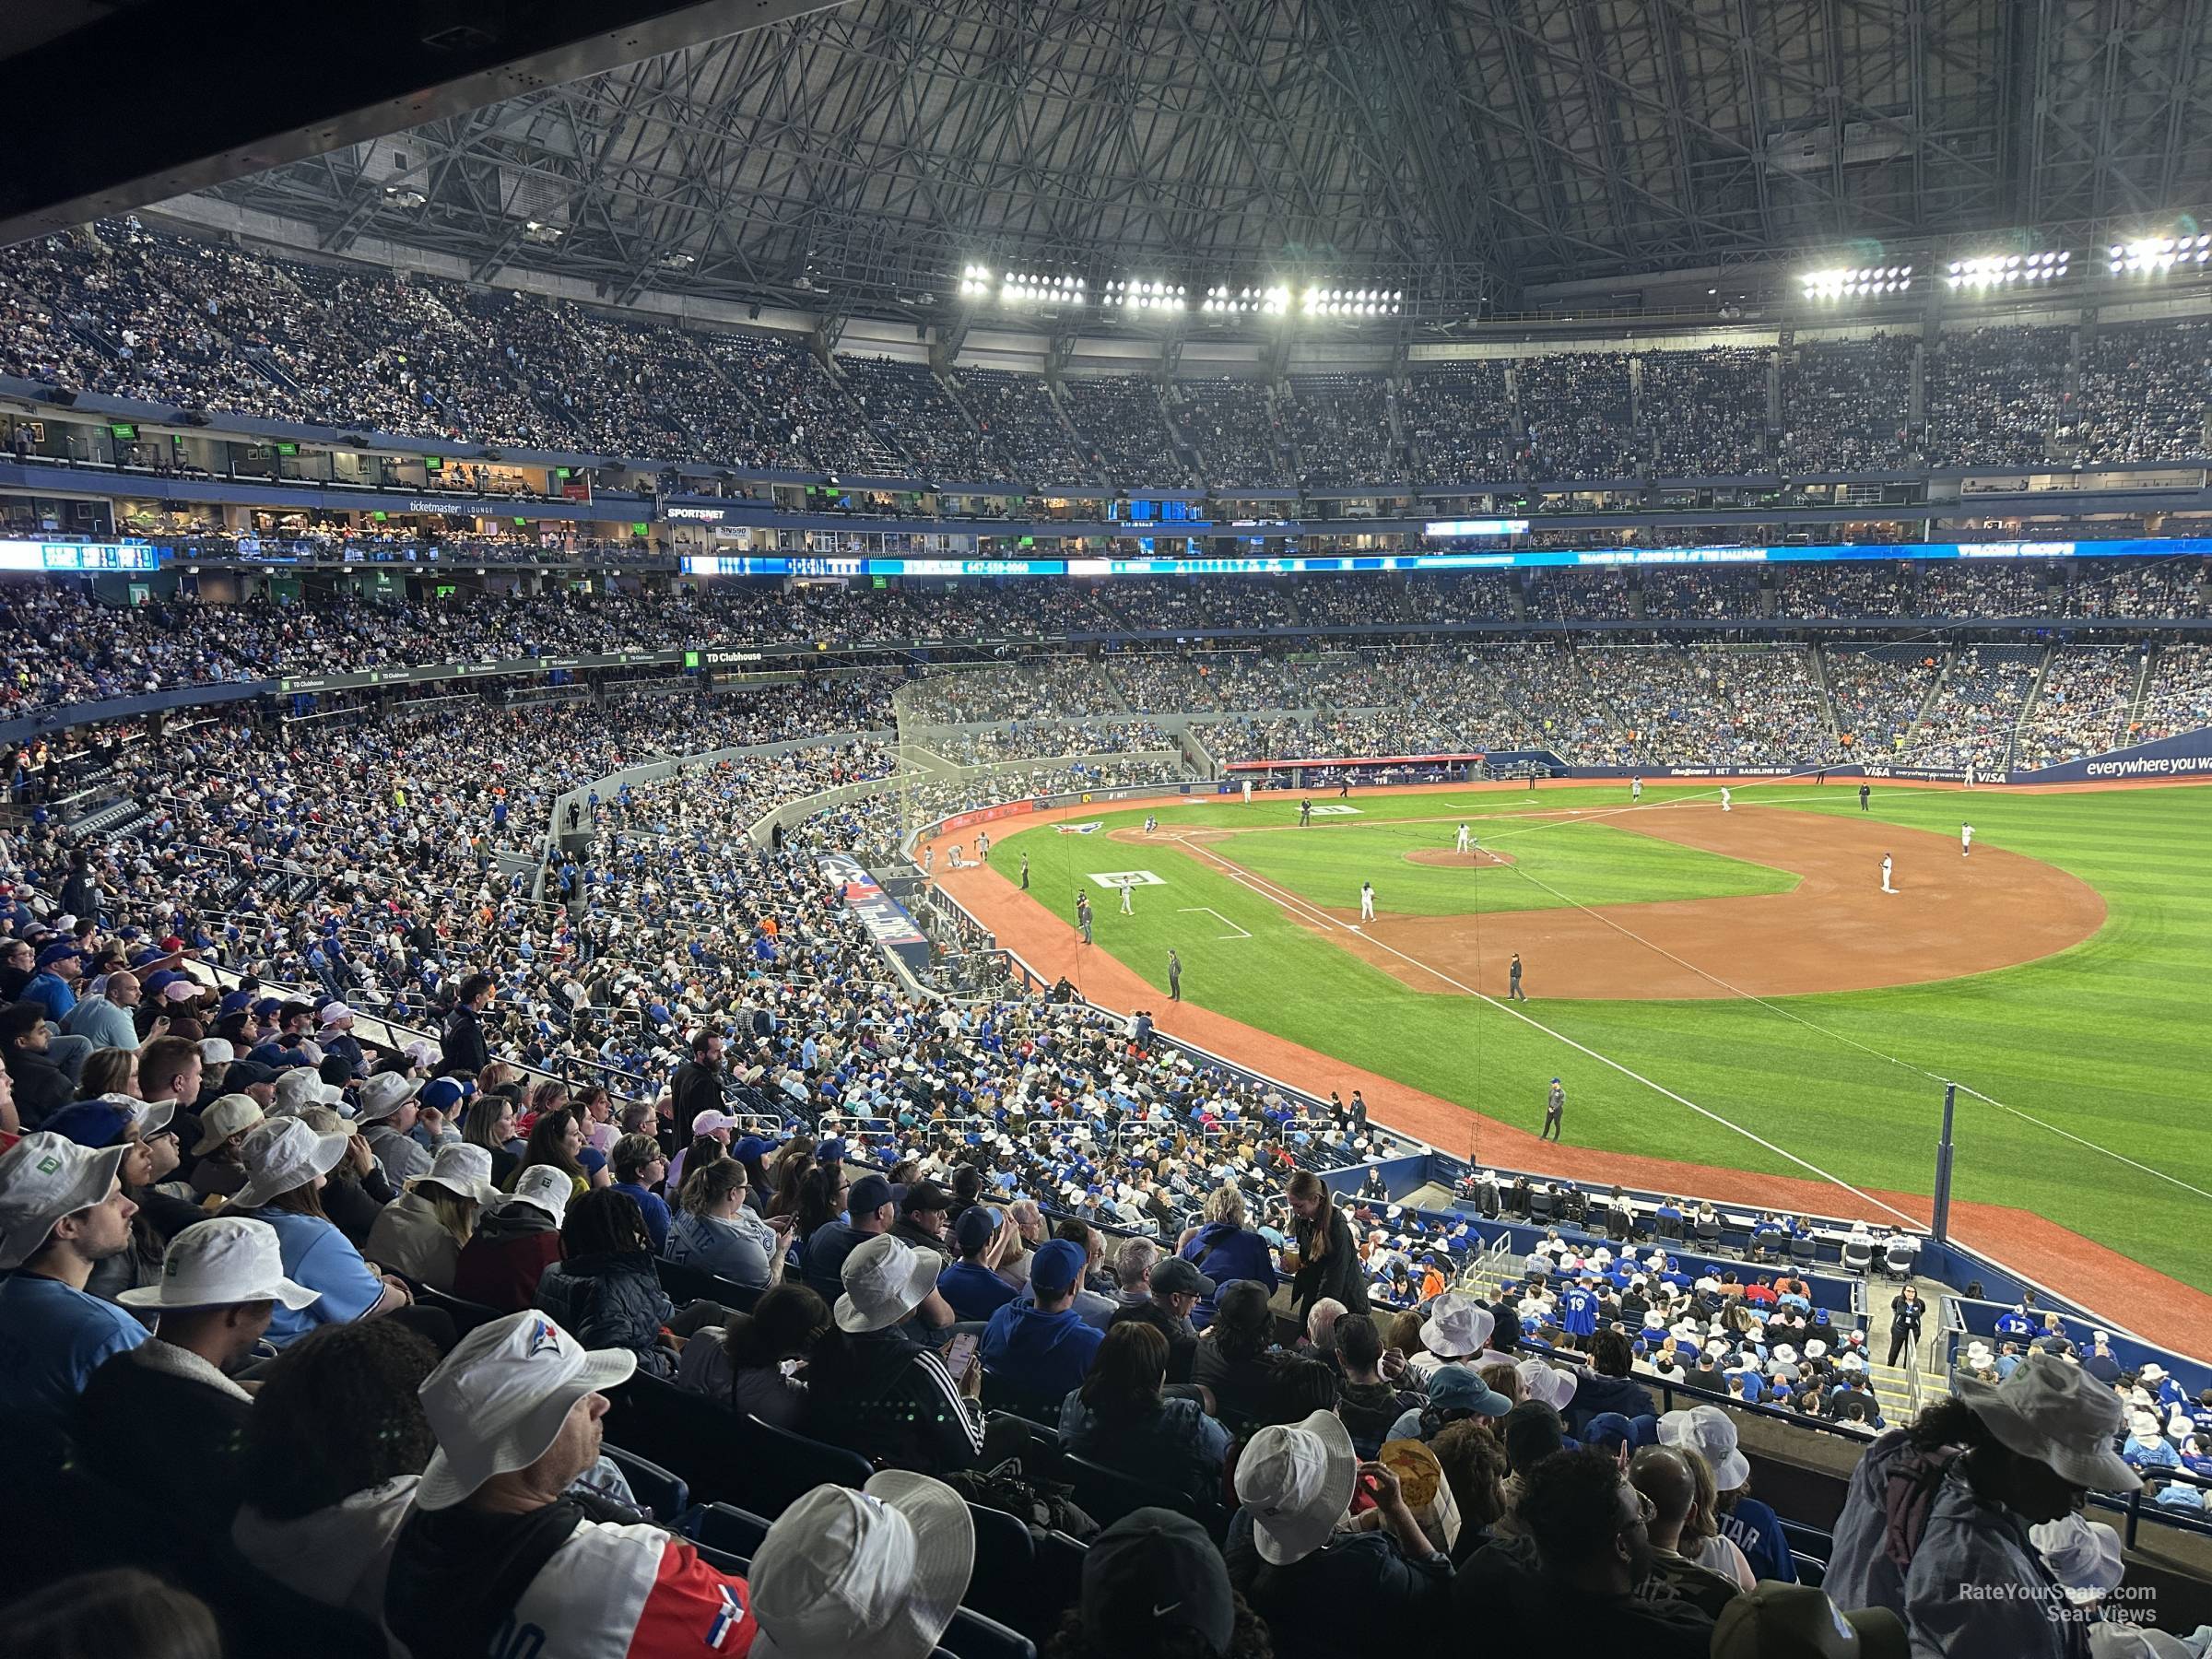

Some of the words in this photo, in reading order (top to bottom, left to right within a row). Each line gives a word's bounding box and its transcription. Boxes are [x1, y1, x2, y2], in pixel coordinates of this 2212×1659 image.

[410, 500, 458, 513] ticketmaster
[668, 509, 724, 519] SPORTSNET
[720, 526, 747, 535] SN590
[1616, 552, 1634, 563] FOR
[1702, 550, 1720, 561] THE
[1721, 549, 1768, 560] BALLPARK
[1958, 545, 2018, 557] WELCOME
[706, 653, 719, 663] TD
[720, 653, 761, 662] Clubhouse
[1671, 768, 1710, 776] theScore
[2087, 758, 2170, 776] everywhere
[2170, 758, 2195, 773] you
[1863, 766, 1889, 777] VISA
[1976, 771, 2006, 783] VISA
[1570, 1297, 1585, 1312] 19
[2009, 1319, 2027, 1334] 12
[1717, 1512, 1760, 1552] TAR
